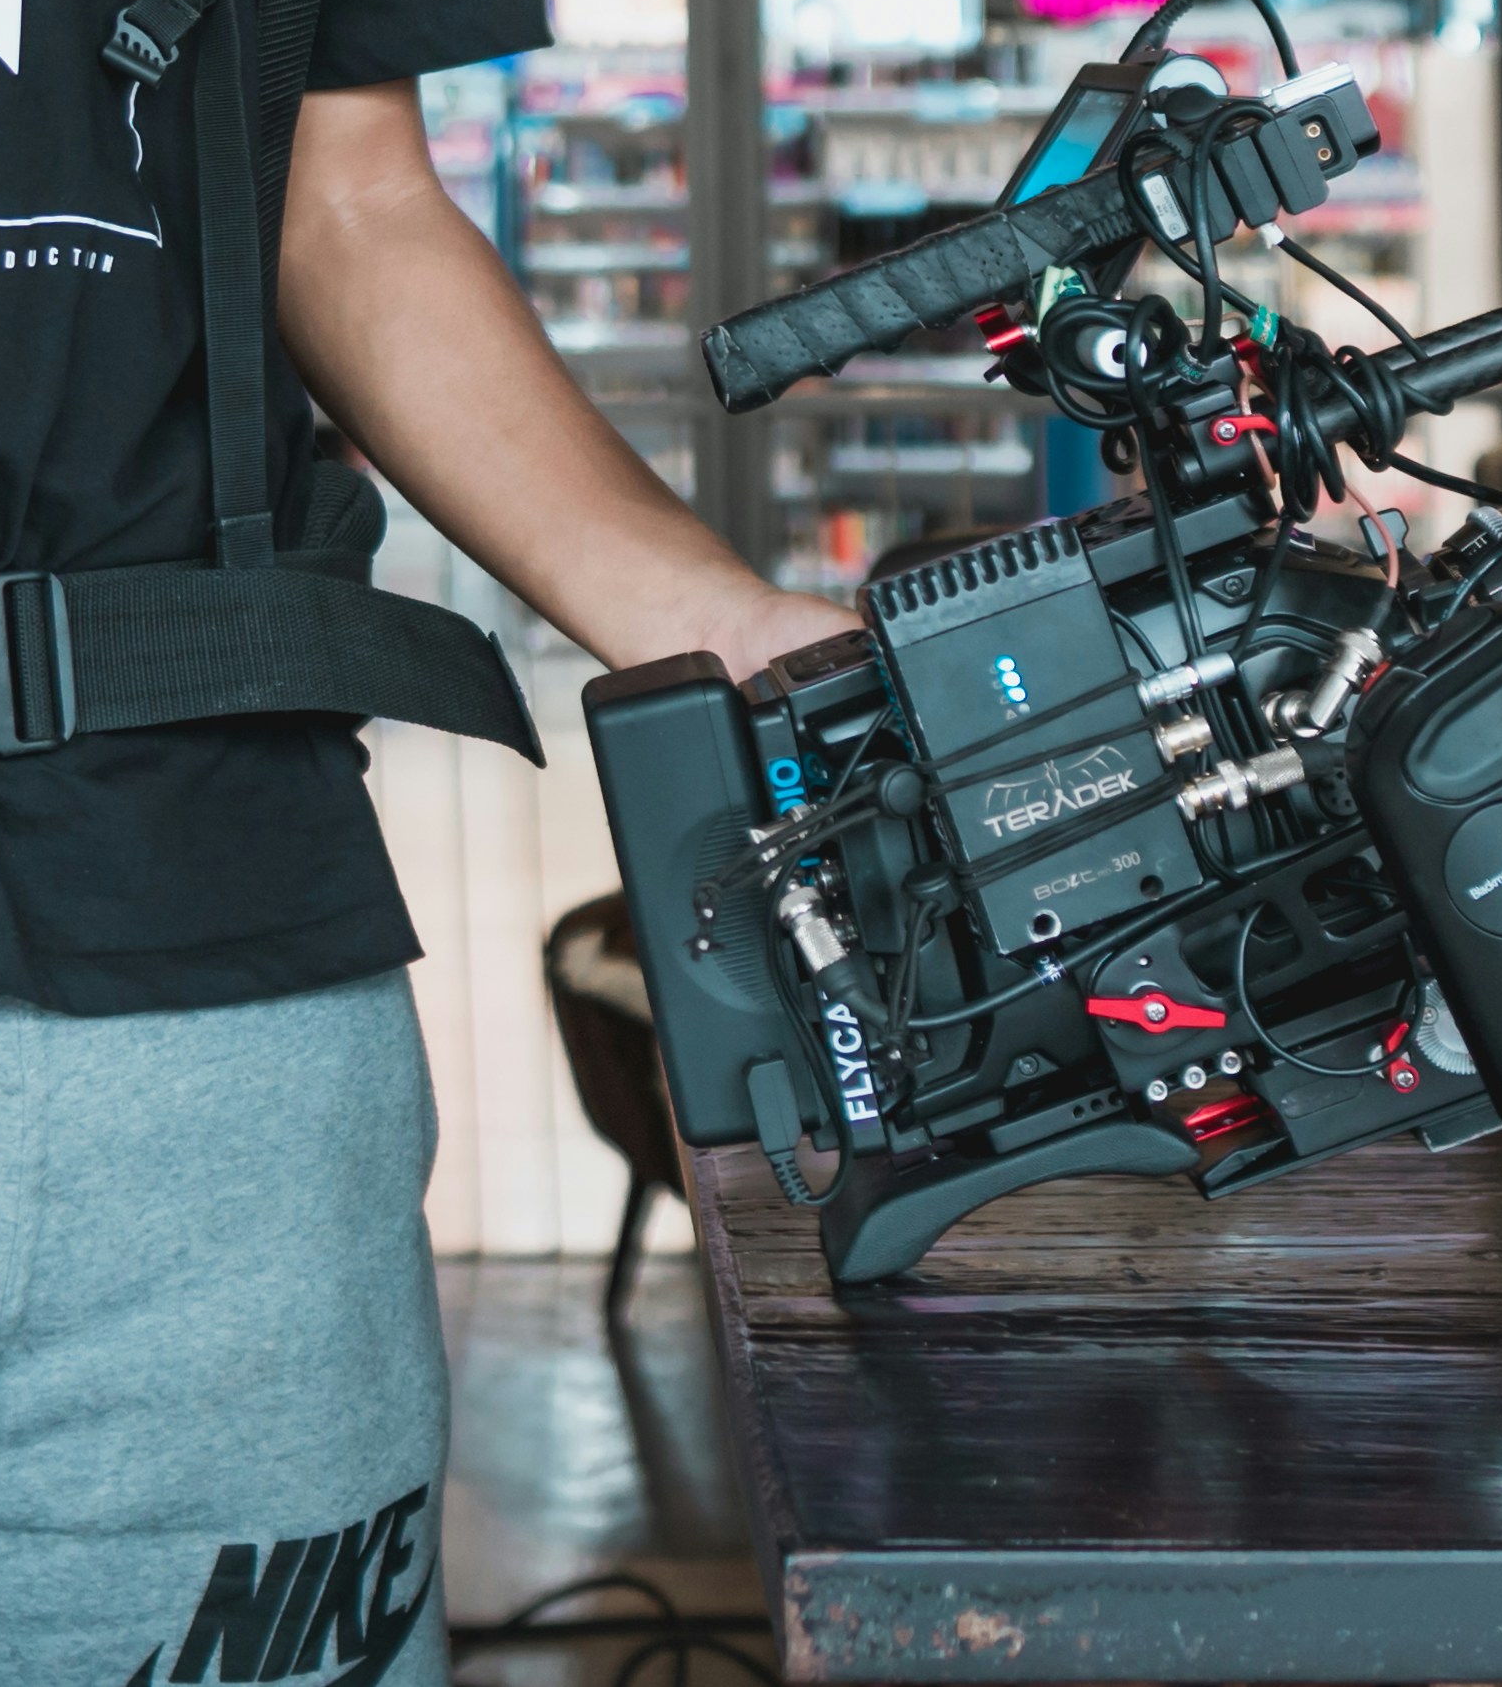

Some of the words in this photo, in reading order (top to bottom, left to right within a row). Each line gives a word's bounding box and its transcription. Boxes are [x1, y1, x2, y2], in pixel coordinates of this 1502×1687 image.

[983, 769, 1140, 838] TERADEK
[1112, 851, 1141, 873] 300
[822, 990, 880, 1122] FLYCA
[168, 1481, 430, 1683] NIKE
